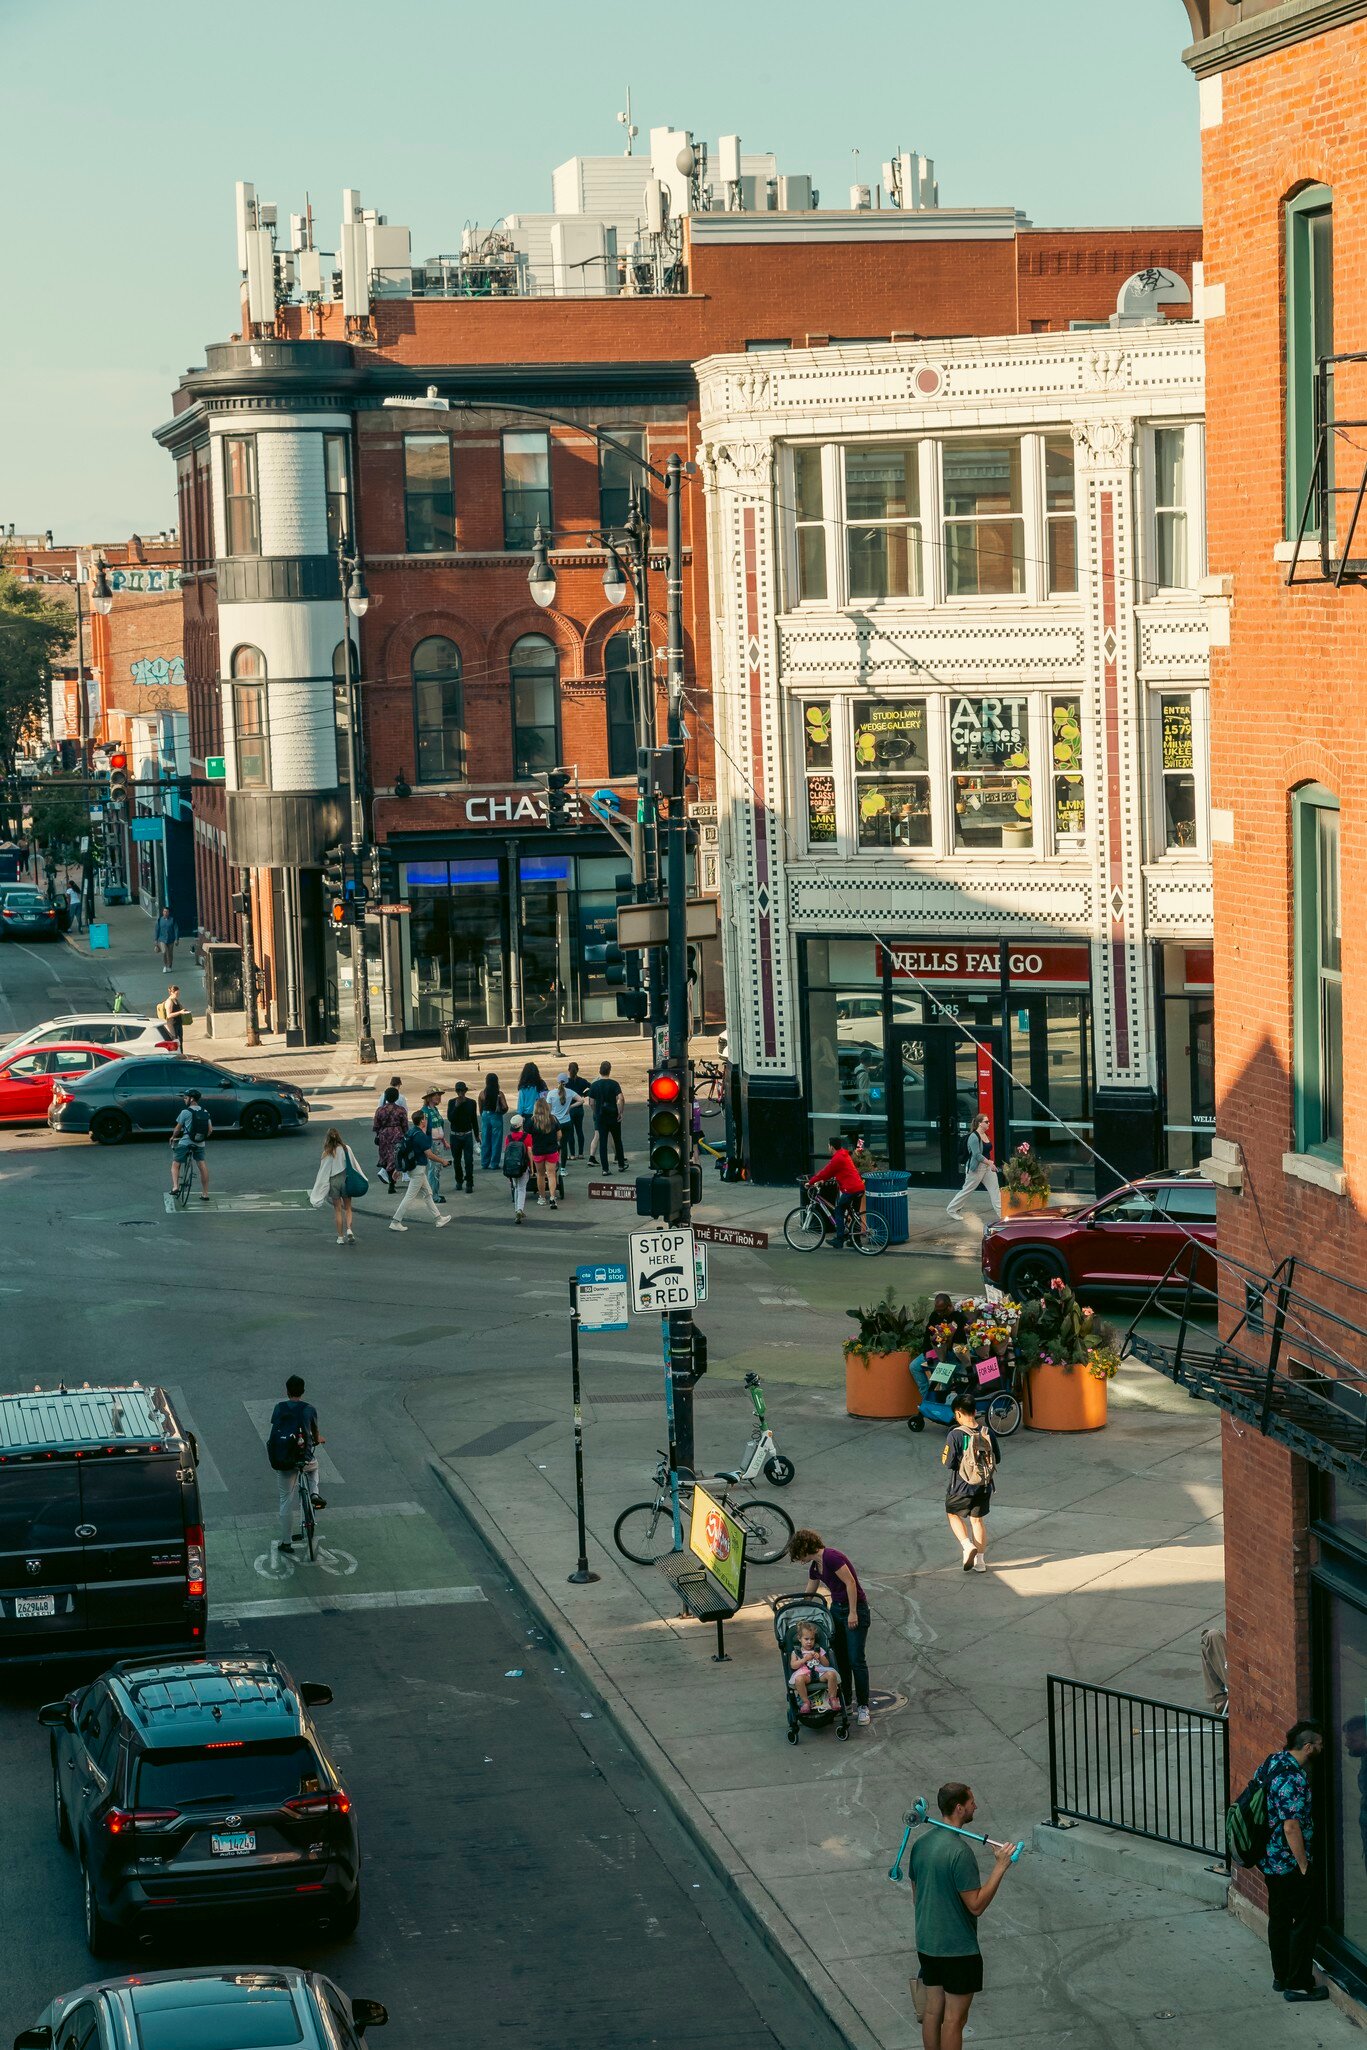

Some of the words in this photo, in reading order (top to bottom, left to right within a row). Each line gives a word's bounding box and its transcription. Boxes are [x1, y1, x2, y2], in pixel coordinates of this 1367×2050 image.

[65, 694, 77, 734] Bucktown
[872, 711, 899, 721] STUDIO
[951, 699, 1026, 729] ART
[1163, 706, 1191, 715] ENTER
[861, 723, 886, 732] WEDGE
[887, 721, 920, 730] GALLERY
[1164, 725, 1192, 735] 1579
[951, 728, 1020, 744] Classes
[970, 743, 1022, 753] EVENTS
[1058, 800, 1084, 810] LMN
[811, 814, 834, 823] LMN
[614, 1190, 631, 1198] WILLIAM
[697, 1229, 711, 1240] THE
[714, 1232, 733, 1243] FLAT
[736, 1236, 754, 1245] IRON
[640, 1237, 684, 1253] STOP
[649, 1254, 676, 1265] HERE
[664, 1276, 679, 1285] ON
[656, 1288, 689, 1304] RED
[978, 1366, 987, 1376] FOR
[987, 1362, 998, 1373] SALE
[18, 1601, 48, 1613] 2629448
[229, 1836, 254, 1851] 14249
